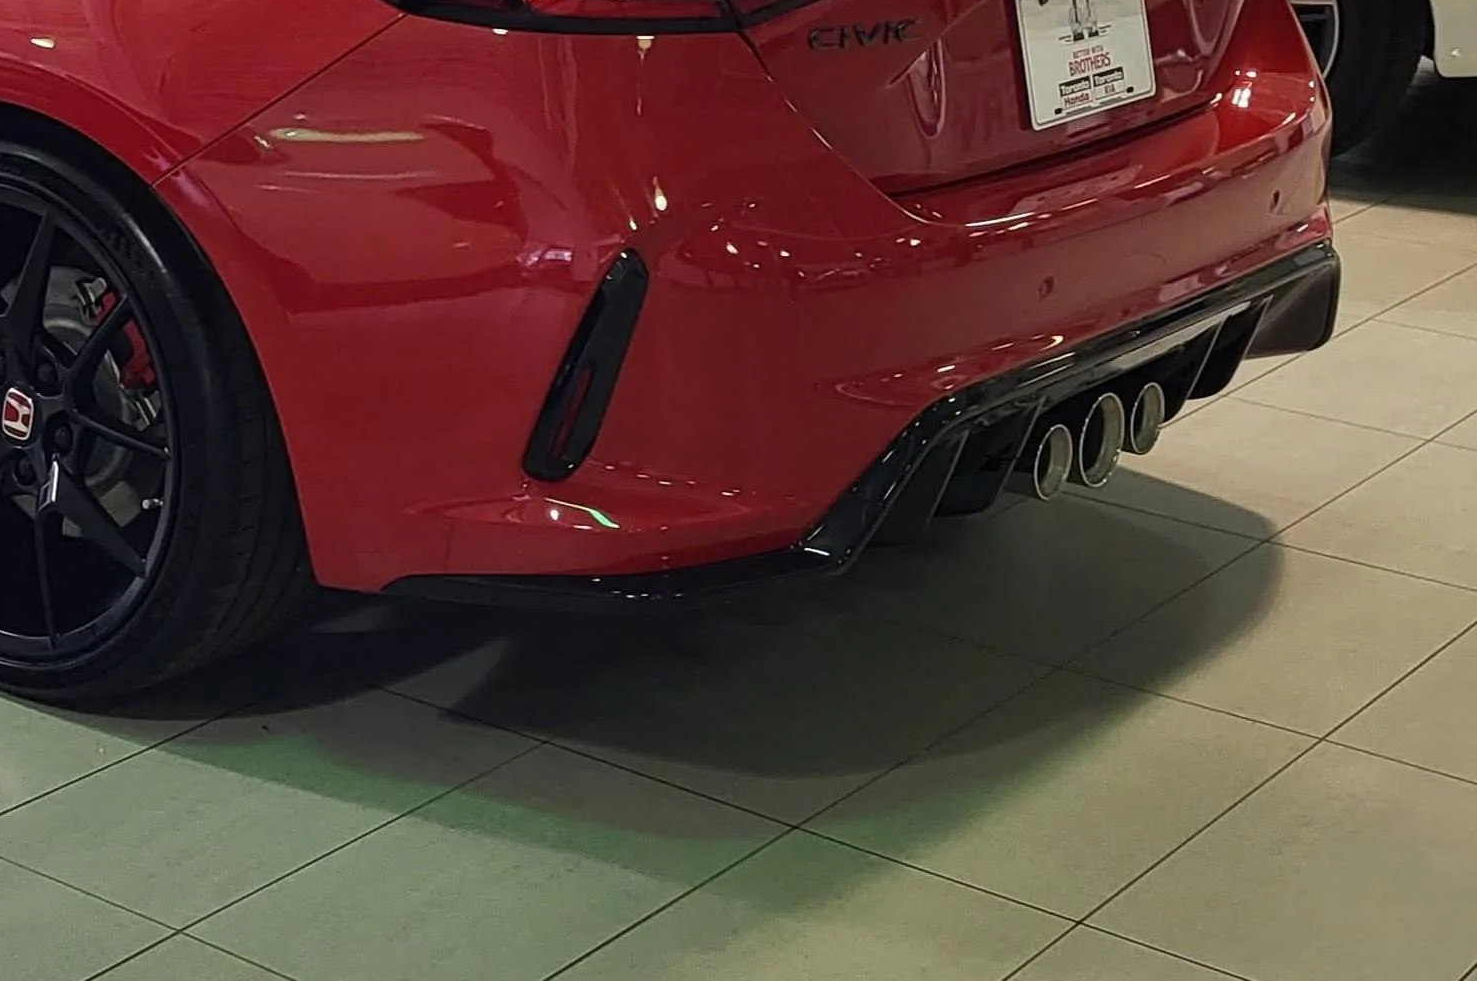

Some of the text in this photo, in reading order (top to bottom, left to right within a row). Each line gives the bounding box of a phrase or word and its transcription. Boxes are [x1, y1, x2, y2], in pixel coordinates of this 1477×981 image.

[808, 18, 920, 50] CIVIC
[1069, 51, 1111, 76] BROTHERS
[1064, 93, 1090, 107] Honda
